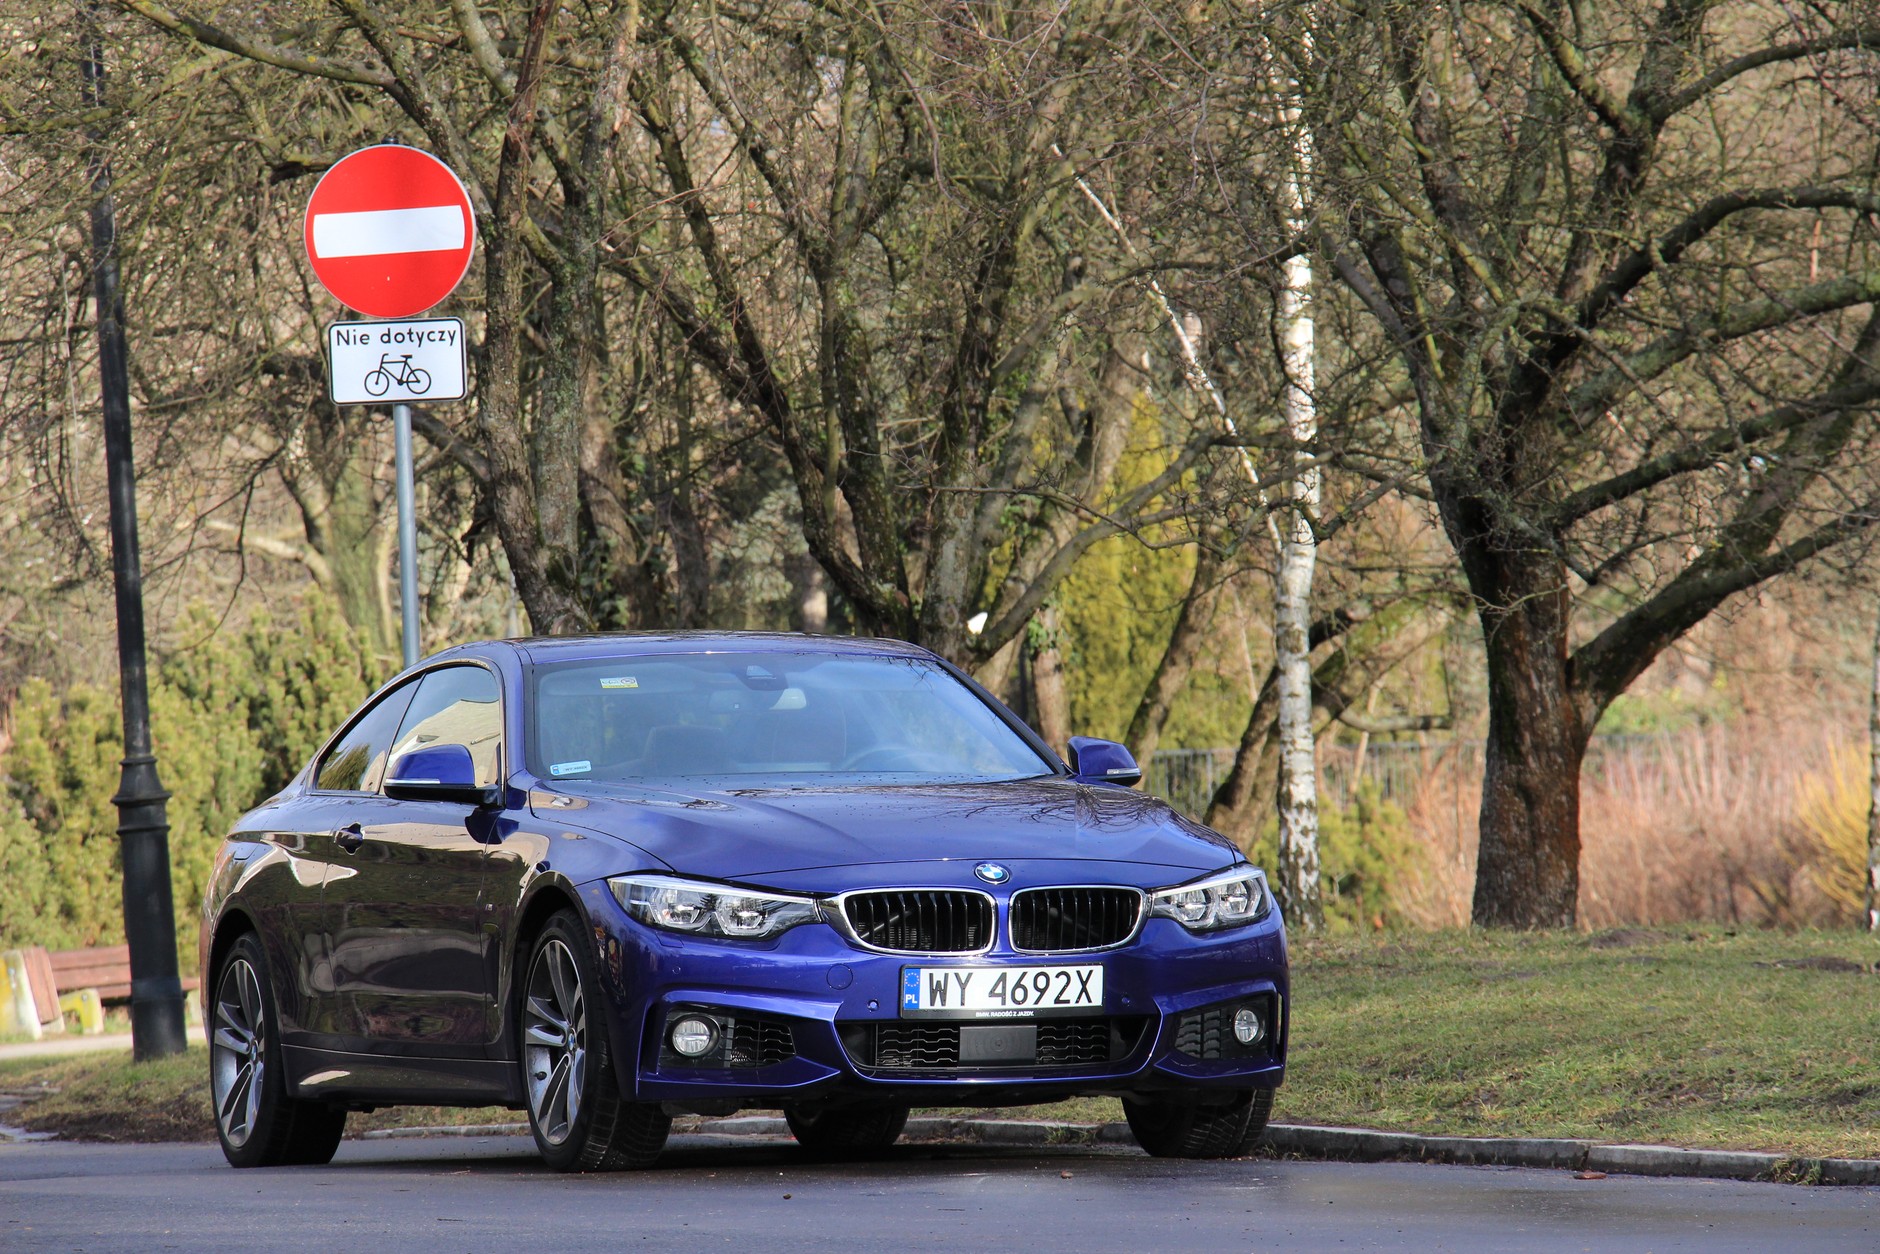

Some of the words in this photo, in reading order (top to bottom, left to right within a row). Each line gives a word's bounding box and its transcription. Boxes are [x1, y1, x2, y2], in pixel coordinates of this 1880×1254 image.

[336, 329, 370, 346] Nie
[380, 327, 457, 348] dotyczy
[928, 972, 974, 1007] WY
[988, 969, 1094, 1006] 4692X
[905, 994, 918, 1004] PL
